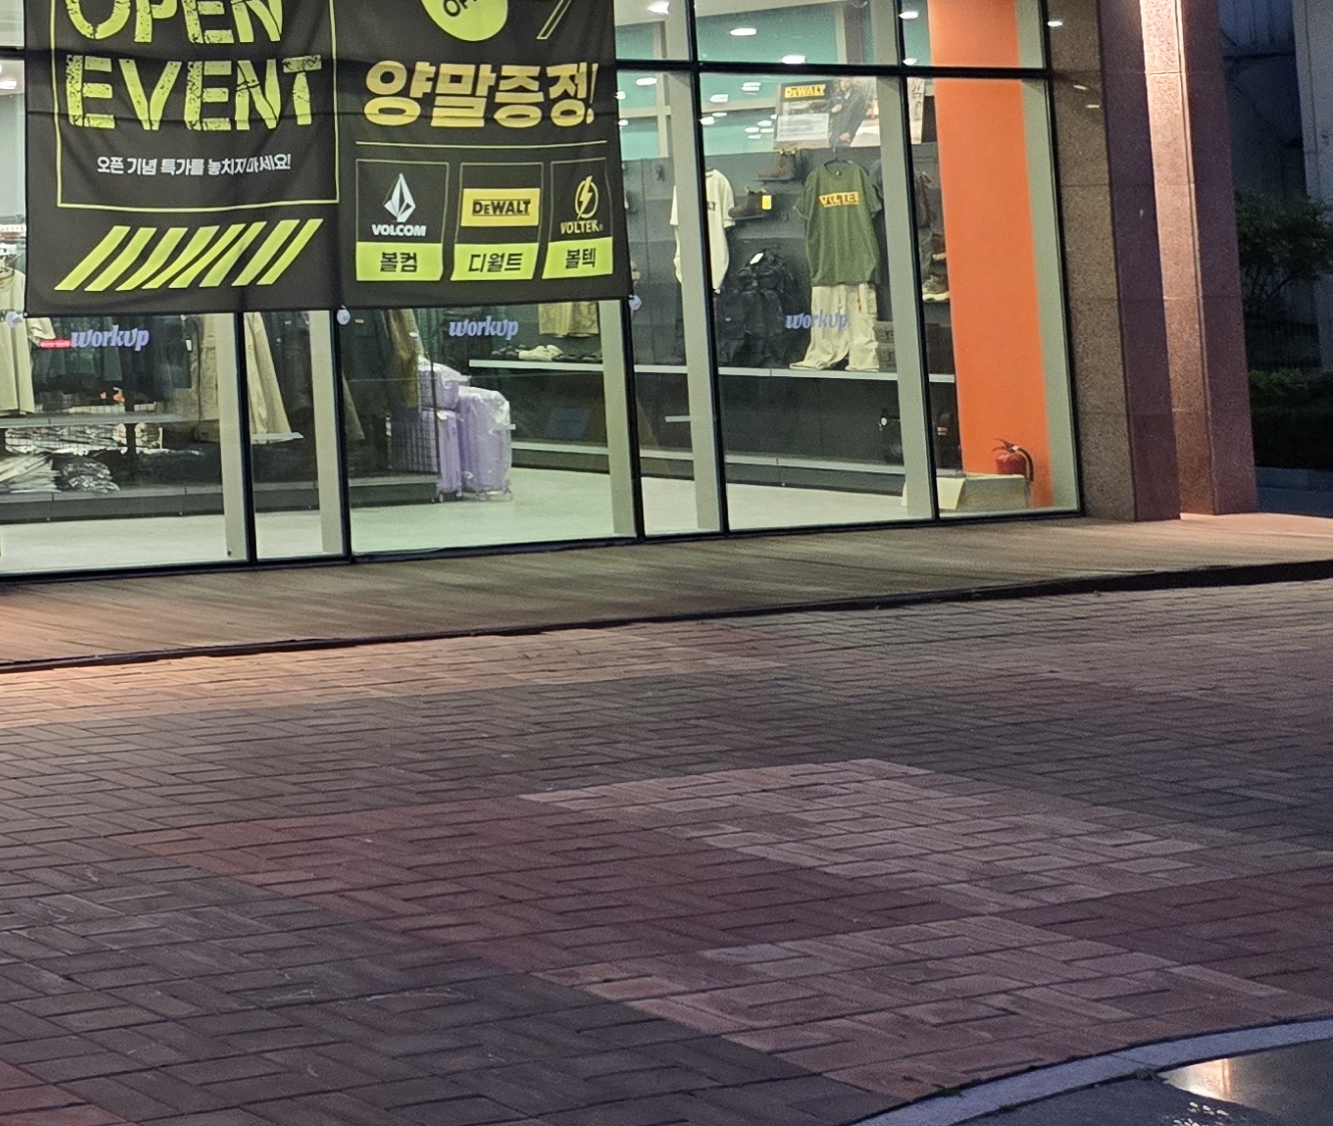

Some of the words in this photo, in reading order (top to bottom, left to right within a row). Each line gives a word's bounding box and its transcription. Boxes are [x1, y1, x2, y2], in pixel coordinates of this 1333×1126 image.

[65, 54, 322, 131] EVENT
[364, 60, 599, 128] 양말증정!
[96, 156, 124, 174] 오픈
[127, 158, 157, 176] 기념
[160, 158, 205, 176] 특가를
[372, 224, 427, 237] VOLCOM
[380, 251, 418, 273] 볼컴
[468, 251, 523, 273] 디월트
[565, 247, 596, 269] 볼텍
[448, 315, 519, 340] workup
[785, 308, 849, 331] workup
[71, 324, 150, 351] workup
